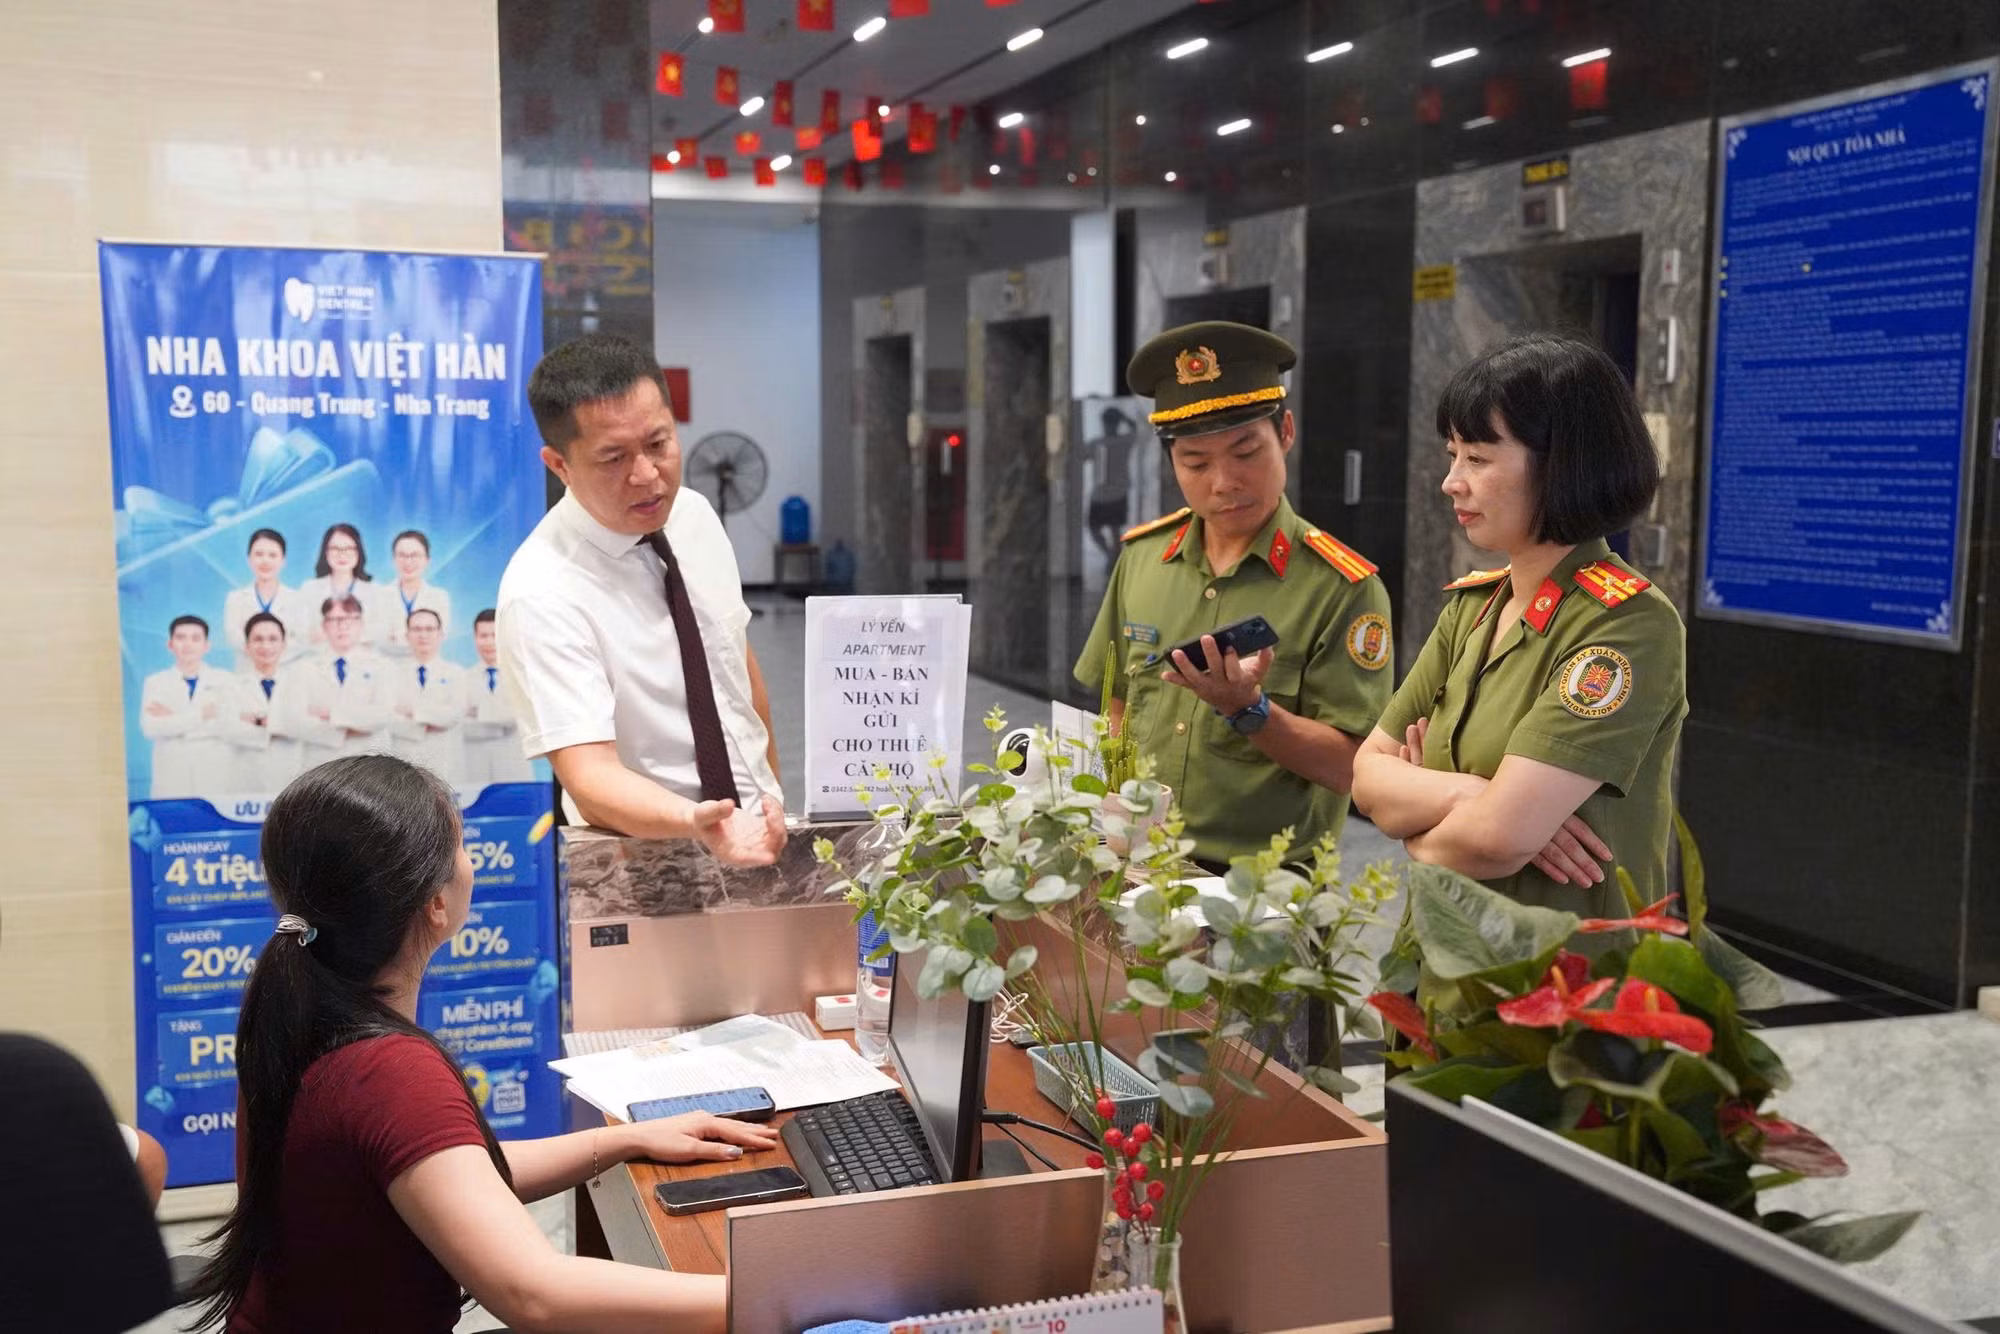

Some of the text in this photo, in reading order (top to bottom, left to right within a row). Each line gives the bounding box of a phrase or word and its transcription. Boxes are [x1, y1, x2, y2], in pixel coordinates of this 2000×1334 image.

[147, 332, 506, 387] NHA KHOA VIỆT HÀN
[202, 390, 231, 414] 60
[251, 391, 316, 419] Quang
[317, 392, 376, 419] Trung
[394, 393, 432, 415] Nha
[434, 393, 490, 420] Trang
[880, 617, 905, 633] YẾN
[843, 644, 926, 656] APARTMENT
[834, 667, 876, 680] MUA
[893, 664, 928, 681] BÁN
[1560, 690, 1613, 716] IMMIGRATION
[832, 734, 928, 752] CHO THUÊ
[844, 760, 882, 776] CĂ
[464, 841, 514, 871] 5%
[165, 854, 267, 891] 4 triệu
[182, 945, 257, 978] 20%
[492, 995, 524, 1019] PHÍ
[190, 1034, 237, 1066] PR
[183, 1113, 219, 1135] GỌI
[1047, 1320, 1066, 1334] 10
